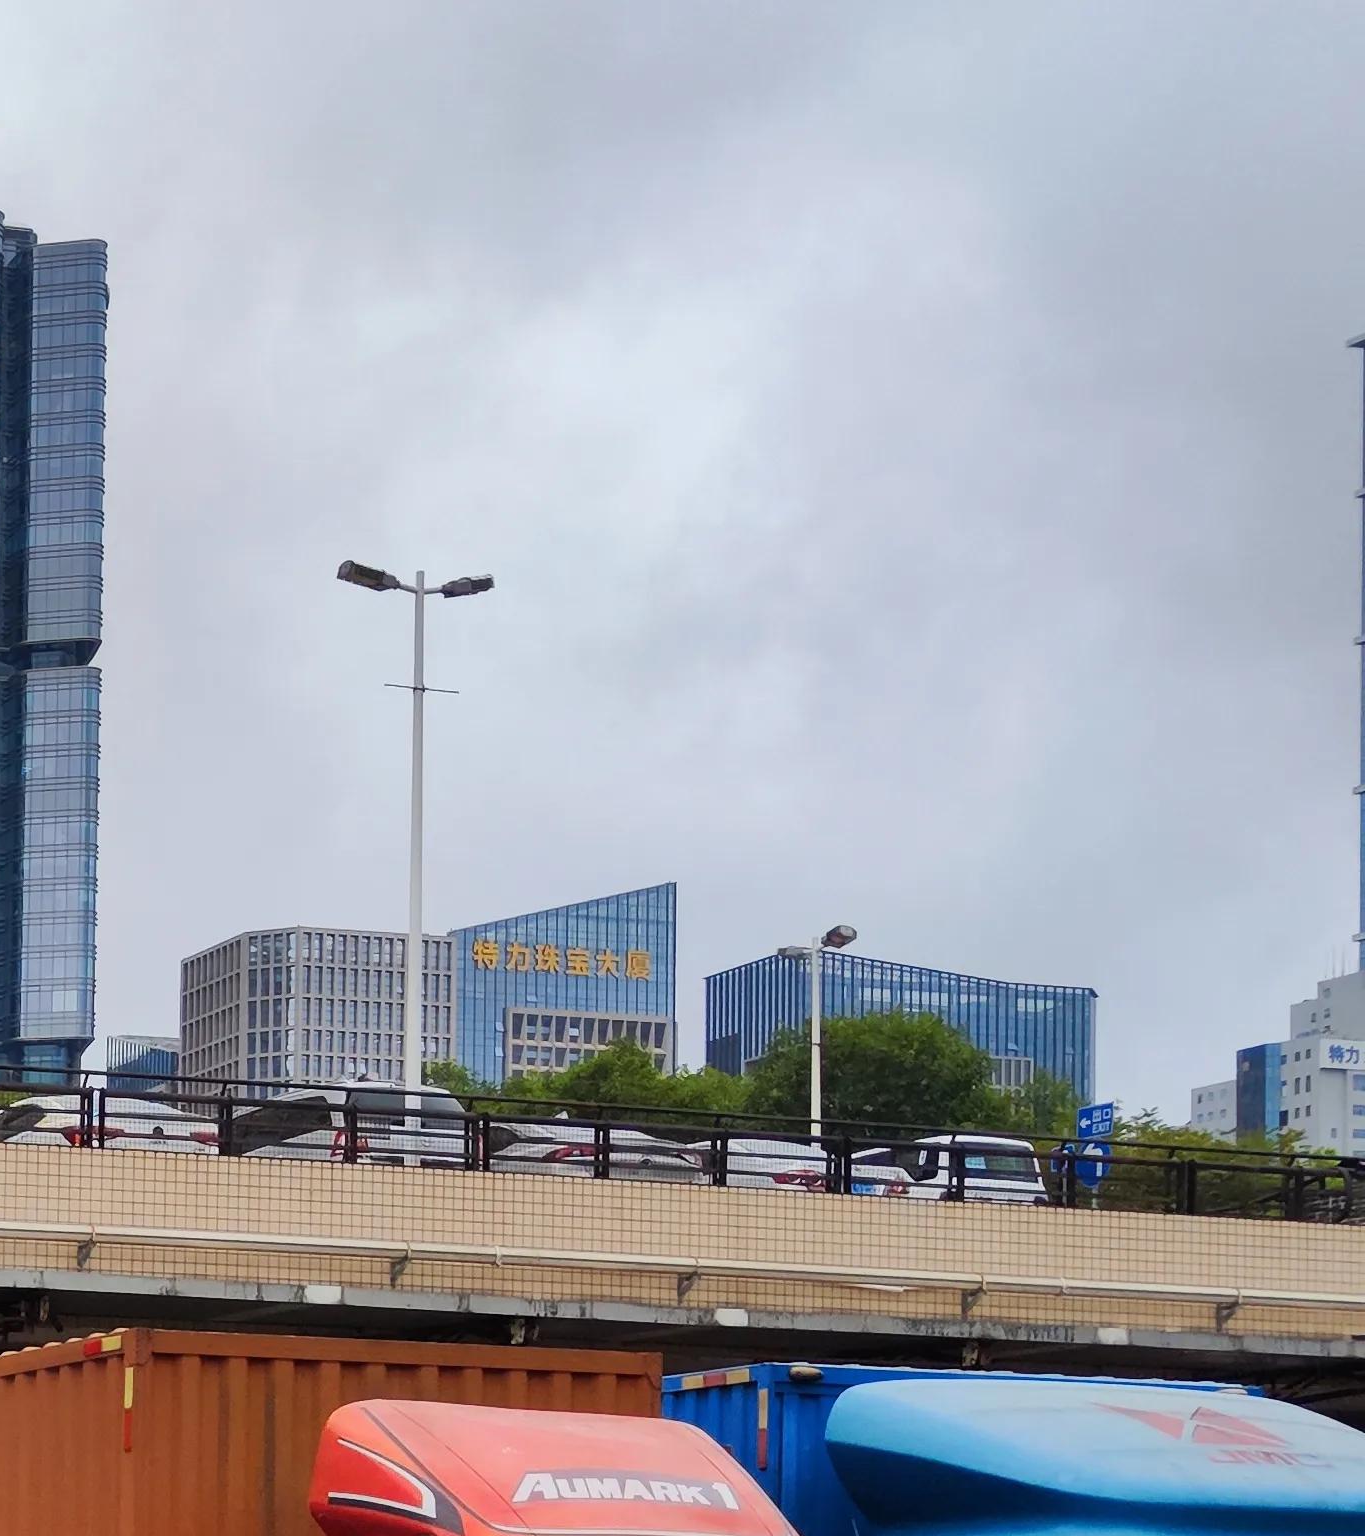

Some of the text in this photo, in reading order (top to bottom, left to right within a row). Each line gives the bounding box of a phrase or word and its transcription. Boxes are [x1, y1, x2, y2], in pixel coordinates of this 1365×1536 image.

[472, 938, 652, 982] 特力珠宝大厦
[1208, 1449, 1334, 1468] JMC
[711, 1481, 739, 1511] 1
